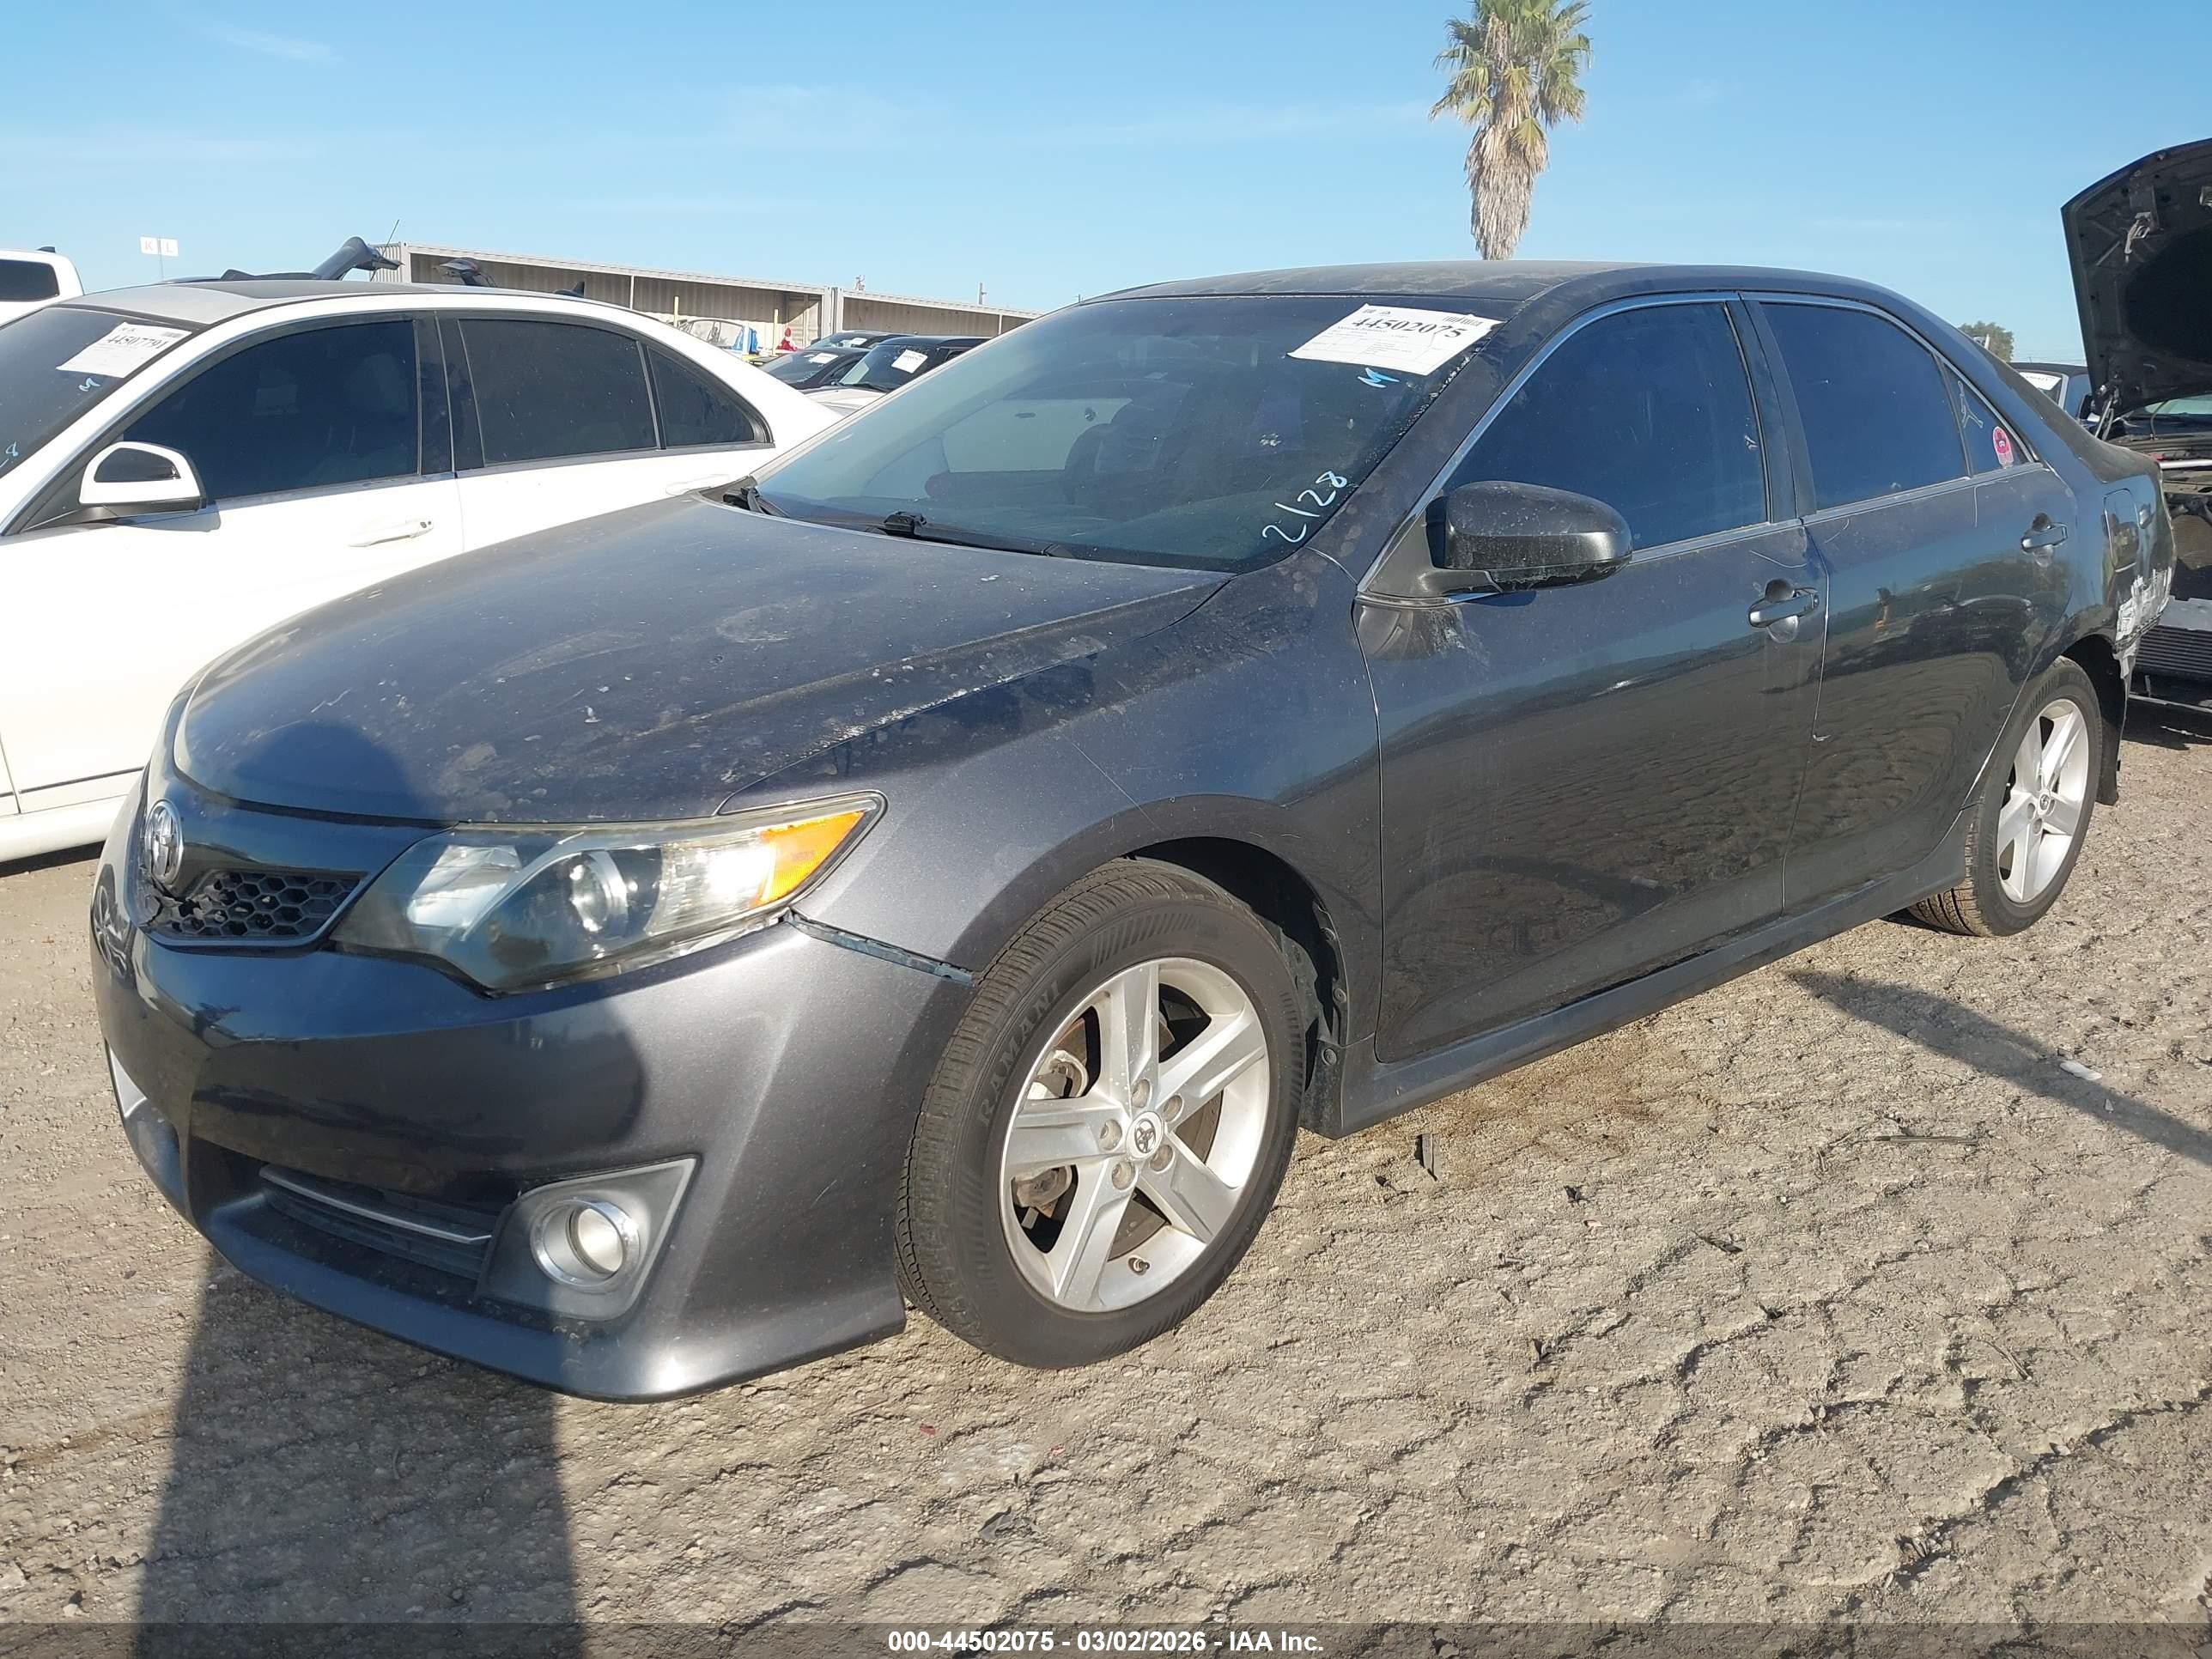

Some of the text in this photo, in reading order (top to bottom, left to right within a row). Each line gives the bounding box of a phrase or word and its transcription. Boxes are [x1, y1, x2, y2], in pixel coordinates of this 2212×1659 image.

[1352, 317, 1467, 338] 44502075
[1261, 471, 1348, 544] 2/28
[978, 980, 1061, 1127] RAMANI
